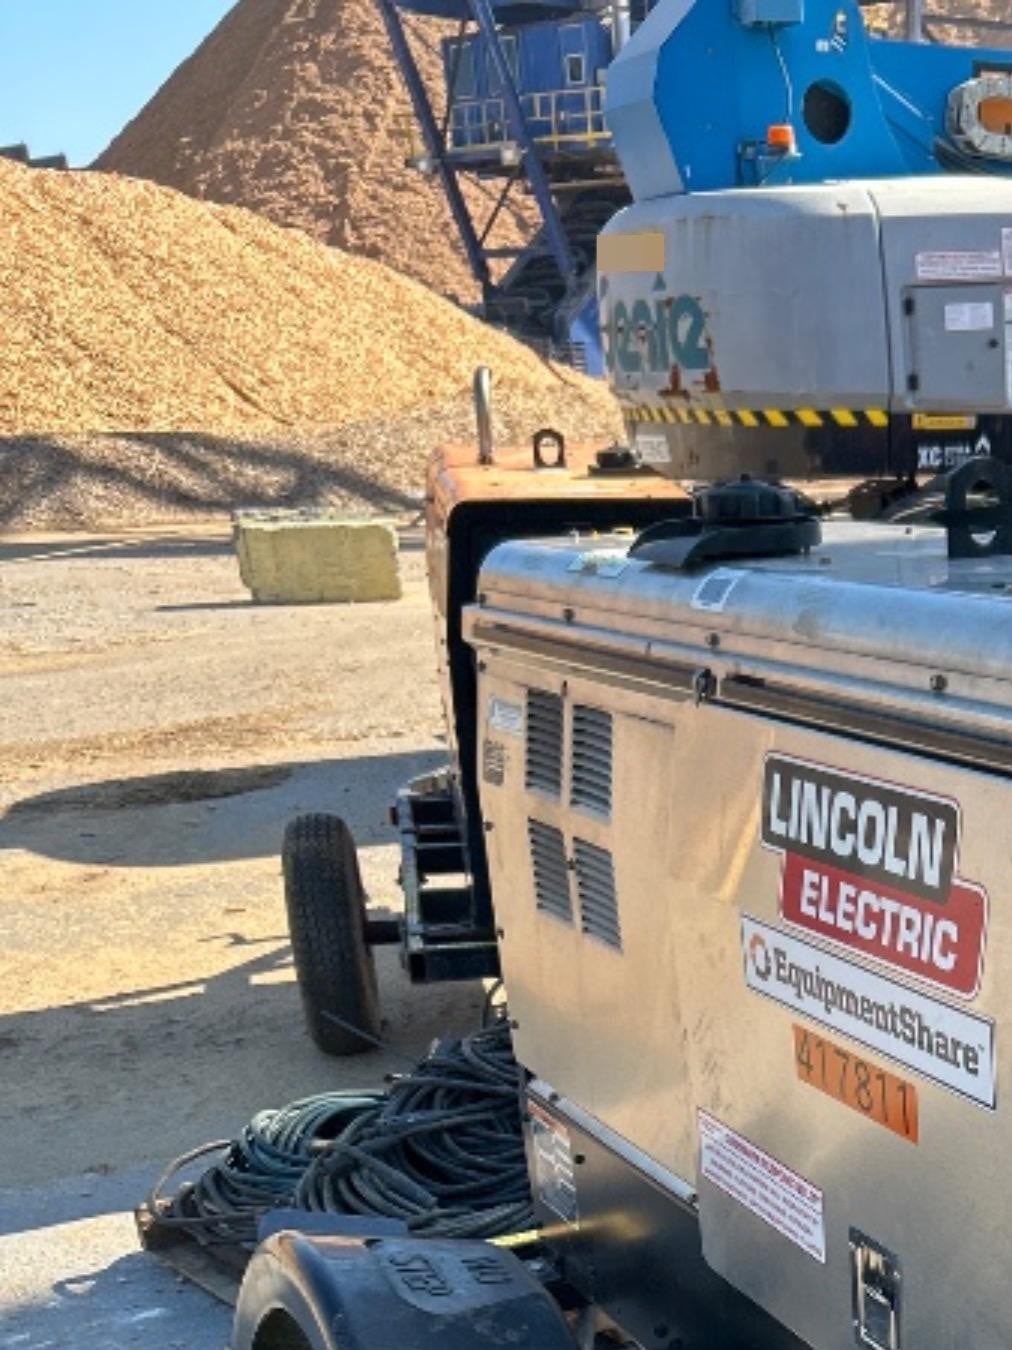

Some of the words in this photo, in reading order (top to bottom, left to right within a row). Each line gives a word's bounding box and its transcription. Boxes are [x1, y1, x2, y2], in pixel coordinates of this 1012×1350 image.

[601, 273, 709, 372] enie
[768, 772, 947, 889] LINCOLN
[800, 868, 959, 973] ELECTRIC
[773, 947, 982, 1077] EquipmentShare
[796, 1033, 912, 1136] 417811
